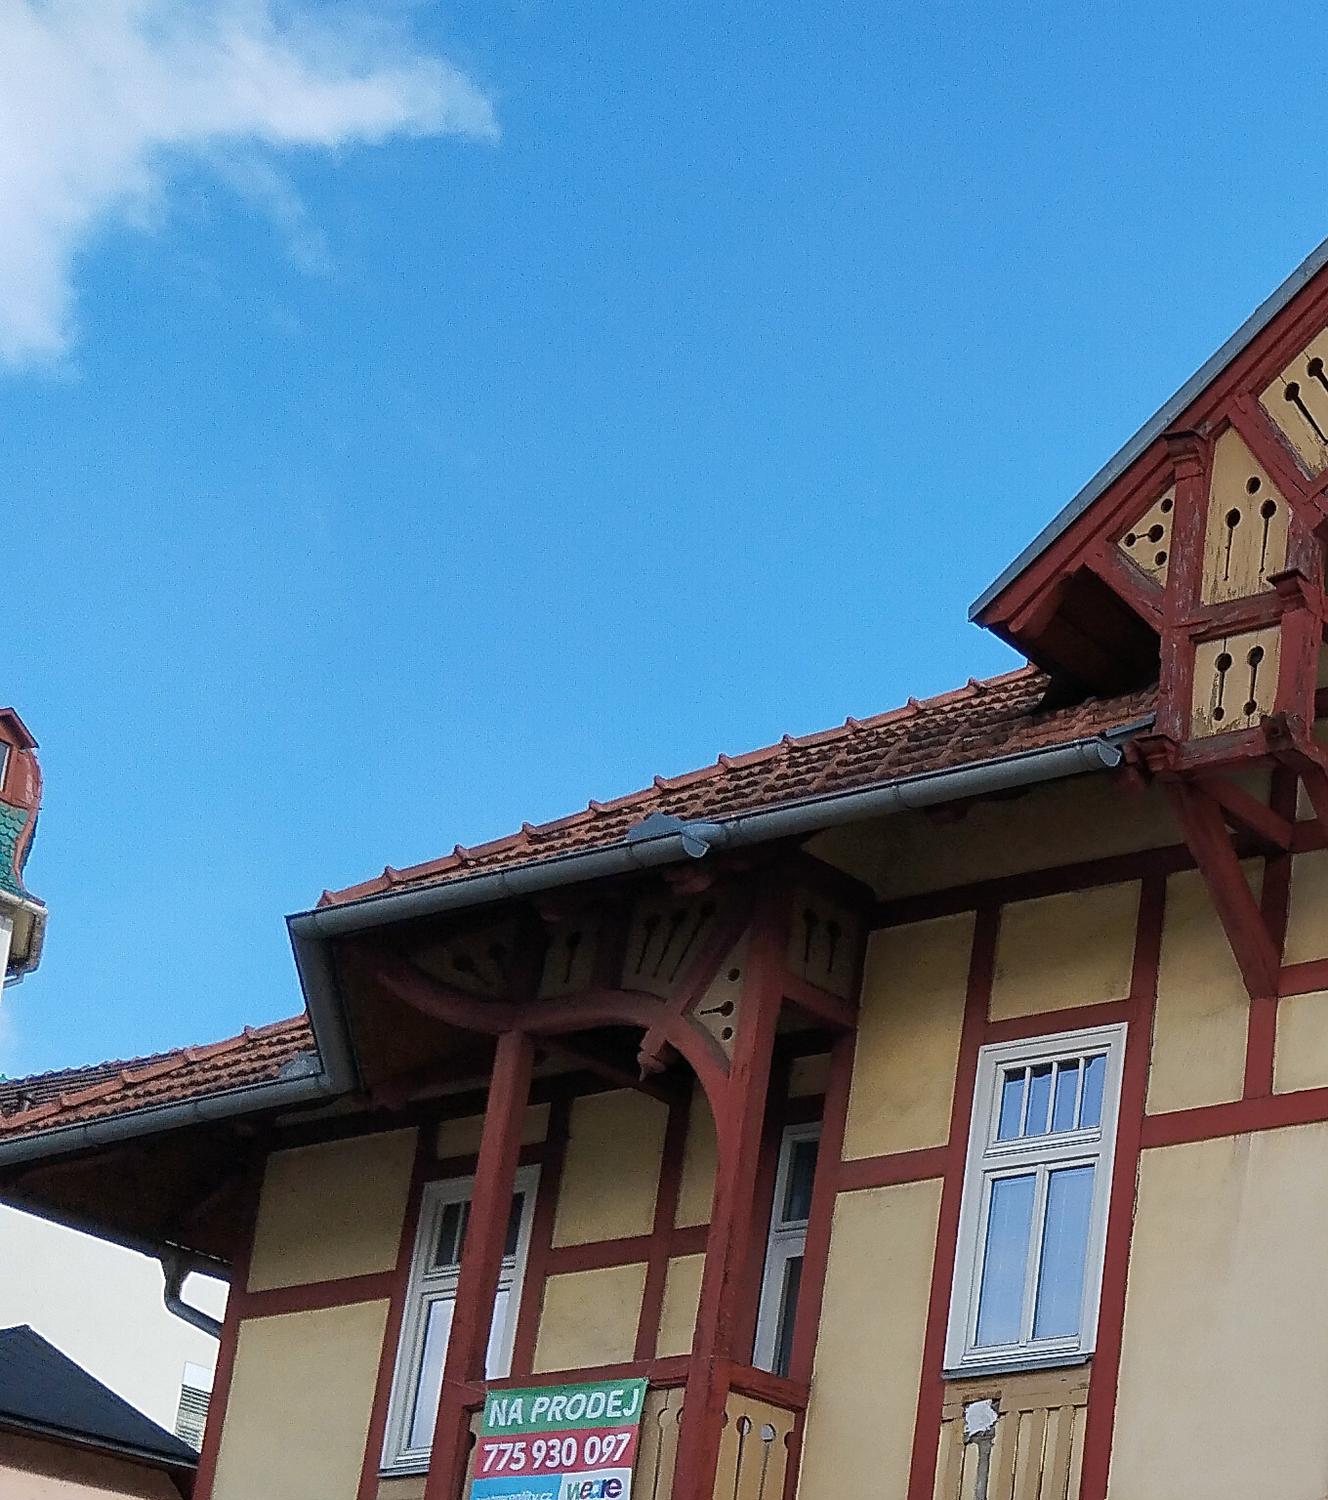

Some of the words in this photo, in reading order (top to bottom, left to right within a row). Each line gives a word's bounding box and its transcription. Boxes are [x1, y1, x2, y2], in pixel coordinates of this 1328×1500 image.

[488, 1398, 523, 1428] NA
[530, 1388, 640, 1423] PRODEJ
[482, 1441, 527, 1472] 775
[532, 1437, 578, 1470] 930
[584, 1432, 631, 1466] 097
